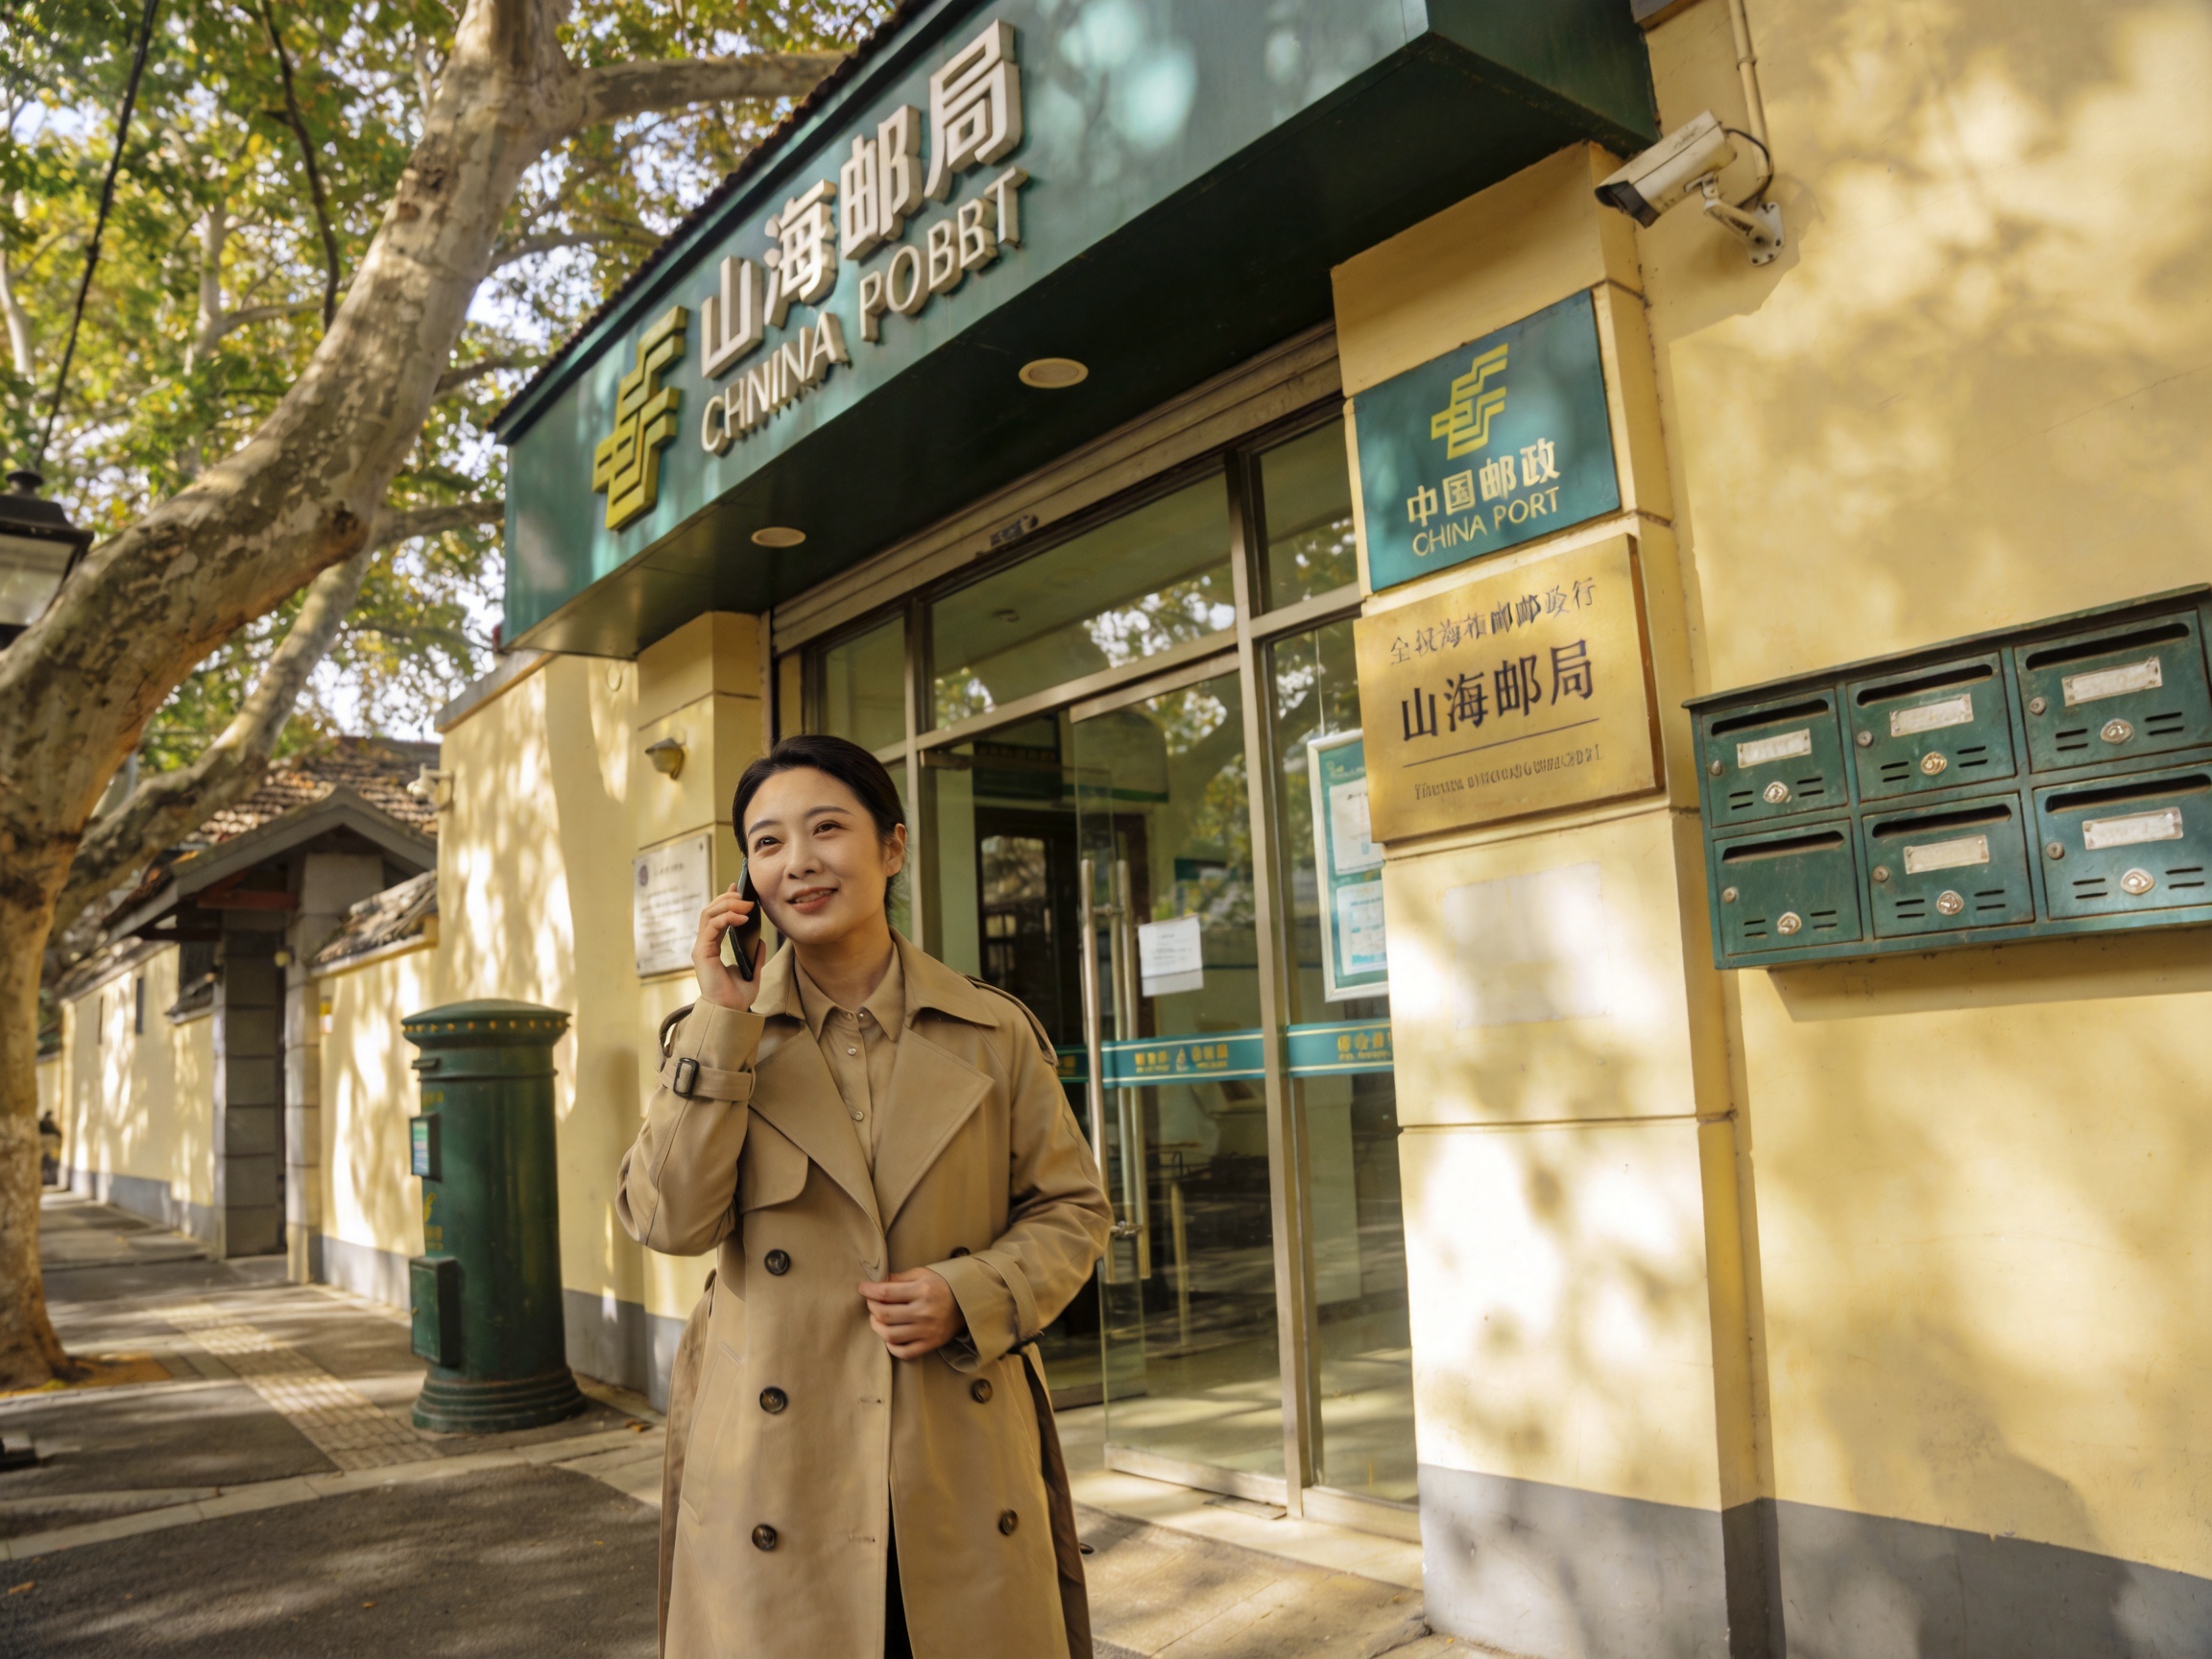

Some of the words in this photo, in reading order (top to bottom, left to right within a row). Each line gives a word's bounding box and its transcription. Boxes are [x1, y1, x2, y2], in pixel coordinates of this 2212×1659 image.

[702, 19, 1023, 379] 山海邮局
[859, 165, 1028, 344] POBBT
[1412, 515, 1488, 558] CHINA
[1494, 486, 1560, 531] PORT
[1401, 638, 1594, 742] 山海邮局
